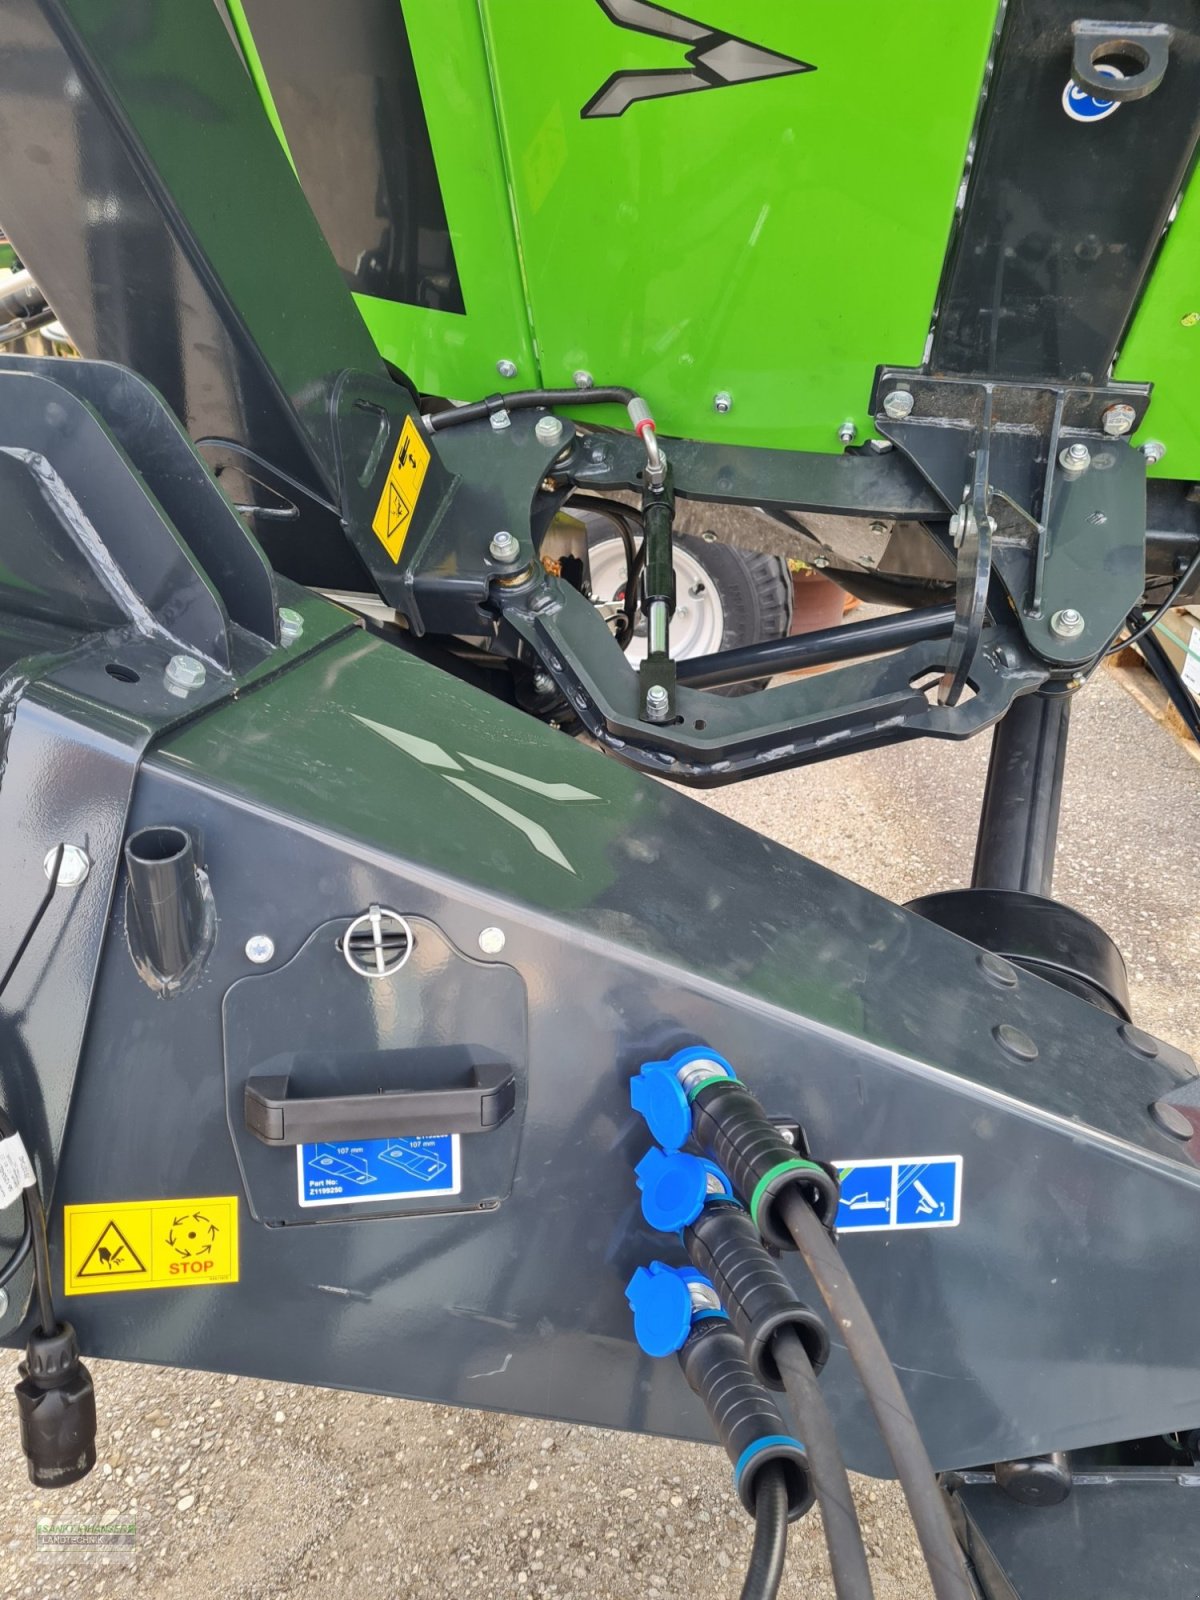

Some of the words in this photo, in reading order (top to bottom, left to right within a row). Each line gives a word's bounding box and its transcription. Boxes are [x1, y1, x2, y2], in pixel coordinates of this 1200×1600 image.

[410, 1140, 422, 1148] 107
[337, 1147, 349, 1155] 107
[325, 1178, 338, 1186] No:
[169, 1260, 214, 1275] STOP
